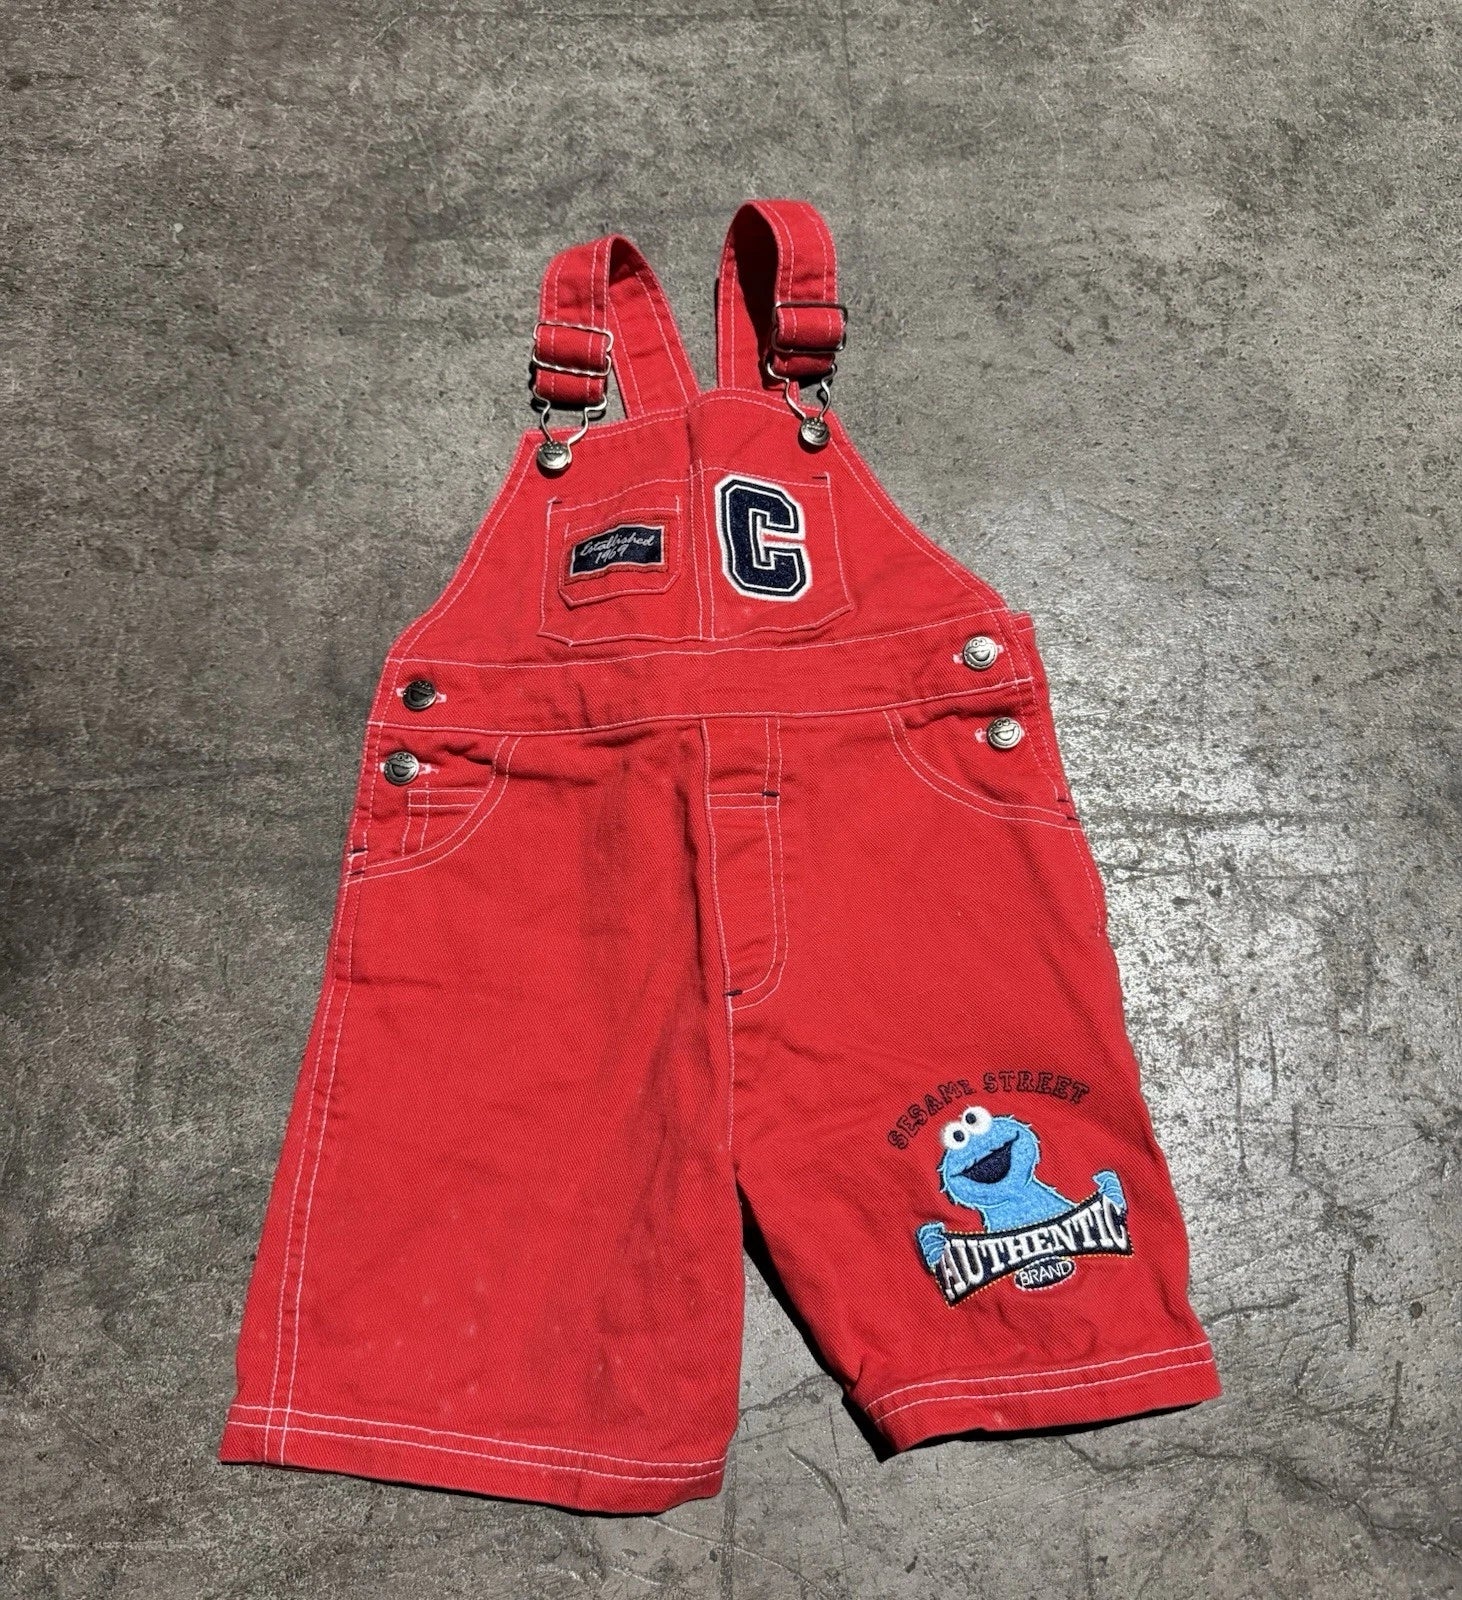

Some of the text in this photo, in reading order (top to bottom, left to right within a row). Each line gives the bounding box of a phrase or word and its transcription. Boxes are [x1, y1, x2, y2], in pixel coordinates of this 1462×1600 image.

[580, 532, 655, 556] Established
[595, 544, 629, 564] 1969
[714, 474, 813, 602] C
[887, 1070, 1090, 1150] SESAME STREET
[940, 1195, 1129, 1301] AUTHENTIC
[1019, 1261, 1072, 1287] BRAND
